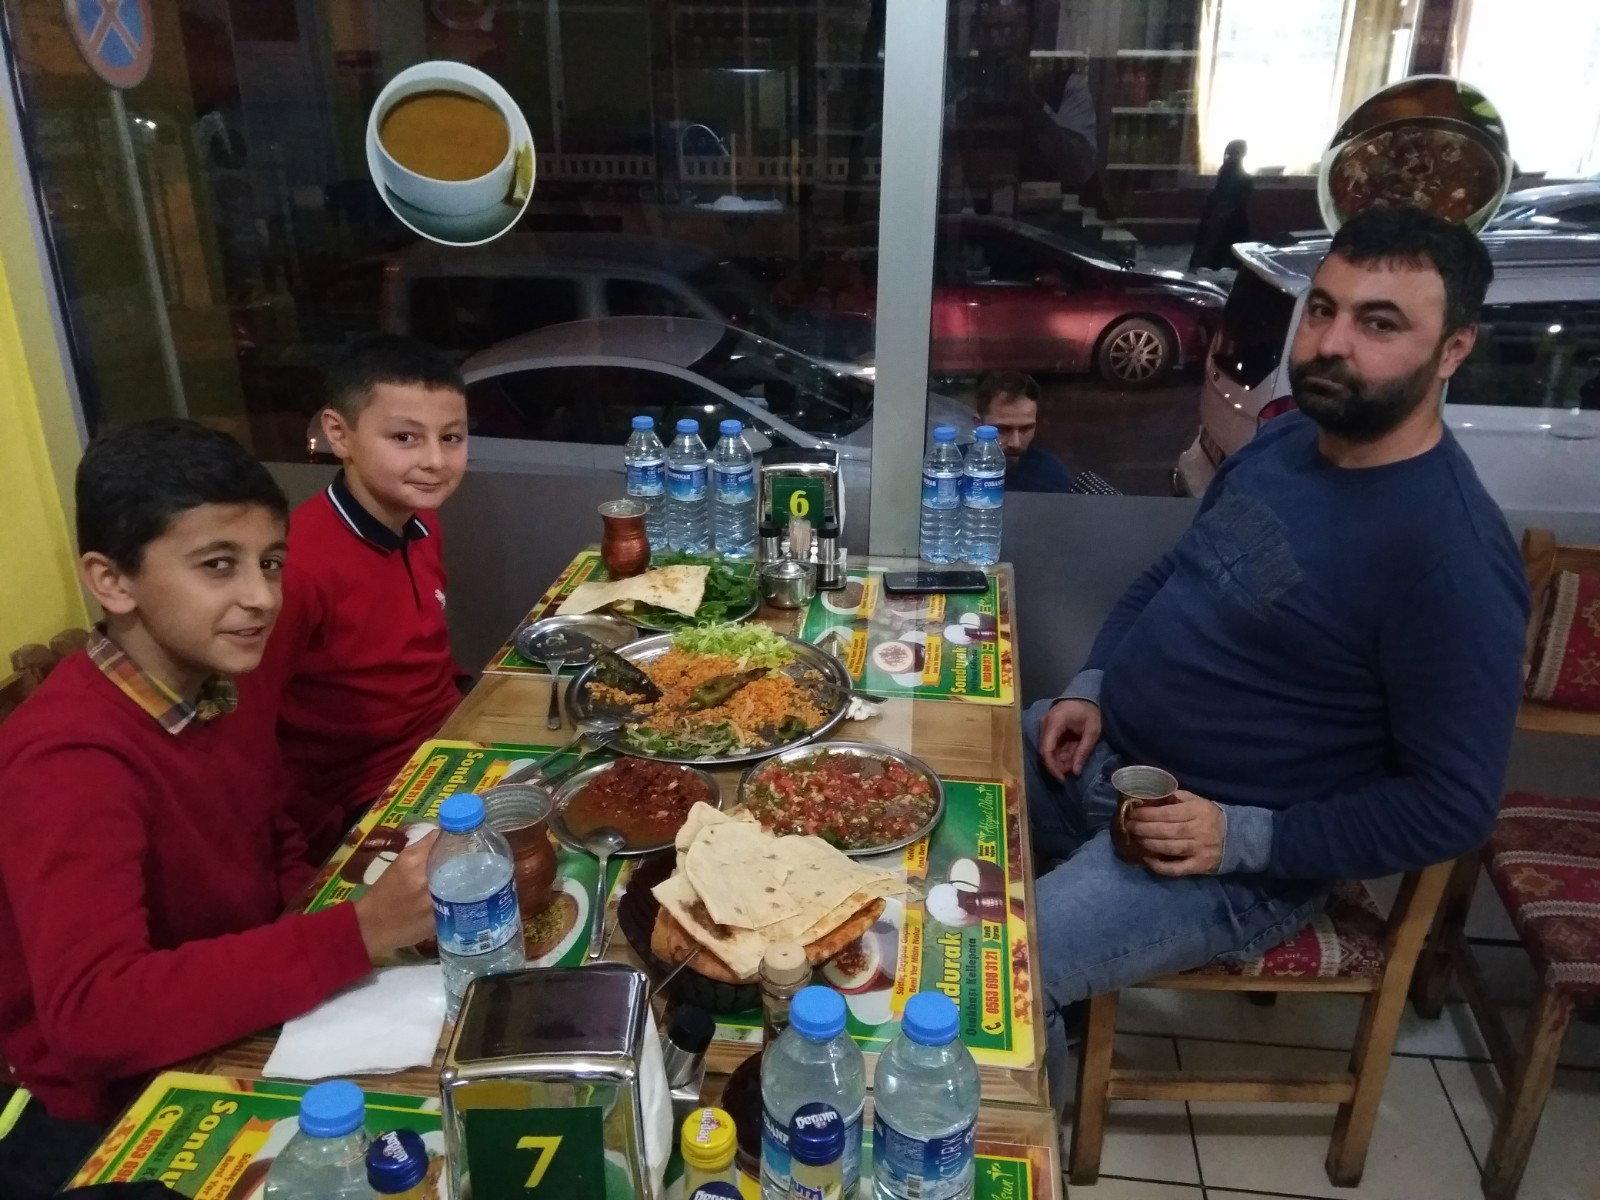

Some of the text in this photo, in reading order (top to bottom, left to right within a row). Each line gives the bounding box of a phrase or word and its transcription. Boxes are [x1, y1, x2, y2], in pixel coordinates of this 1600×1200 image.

[789, 489, 810, 518] 6
[950, 646, 968, 694] Sondurak
[908, 977, 917, 993] Beni
[910, 964, 919, 976] Yer
[936, 932, 962, 1011] durak
[985, 951, 1000, 1015] 0553 698 31 21
[158, 1099, 239, 1189] Sondu
[795, 1111, 838, 1130] uludağ
[516, 1135, 564, 1189] 7
